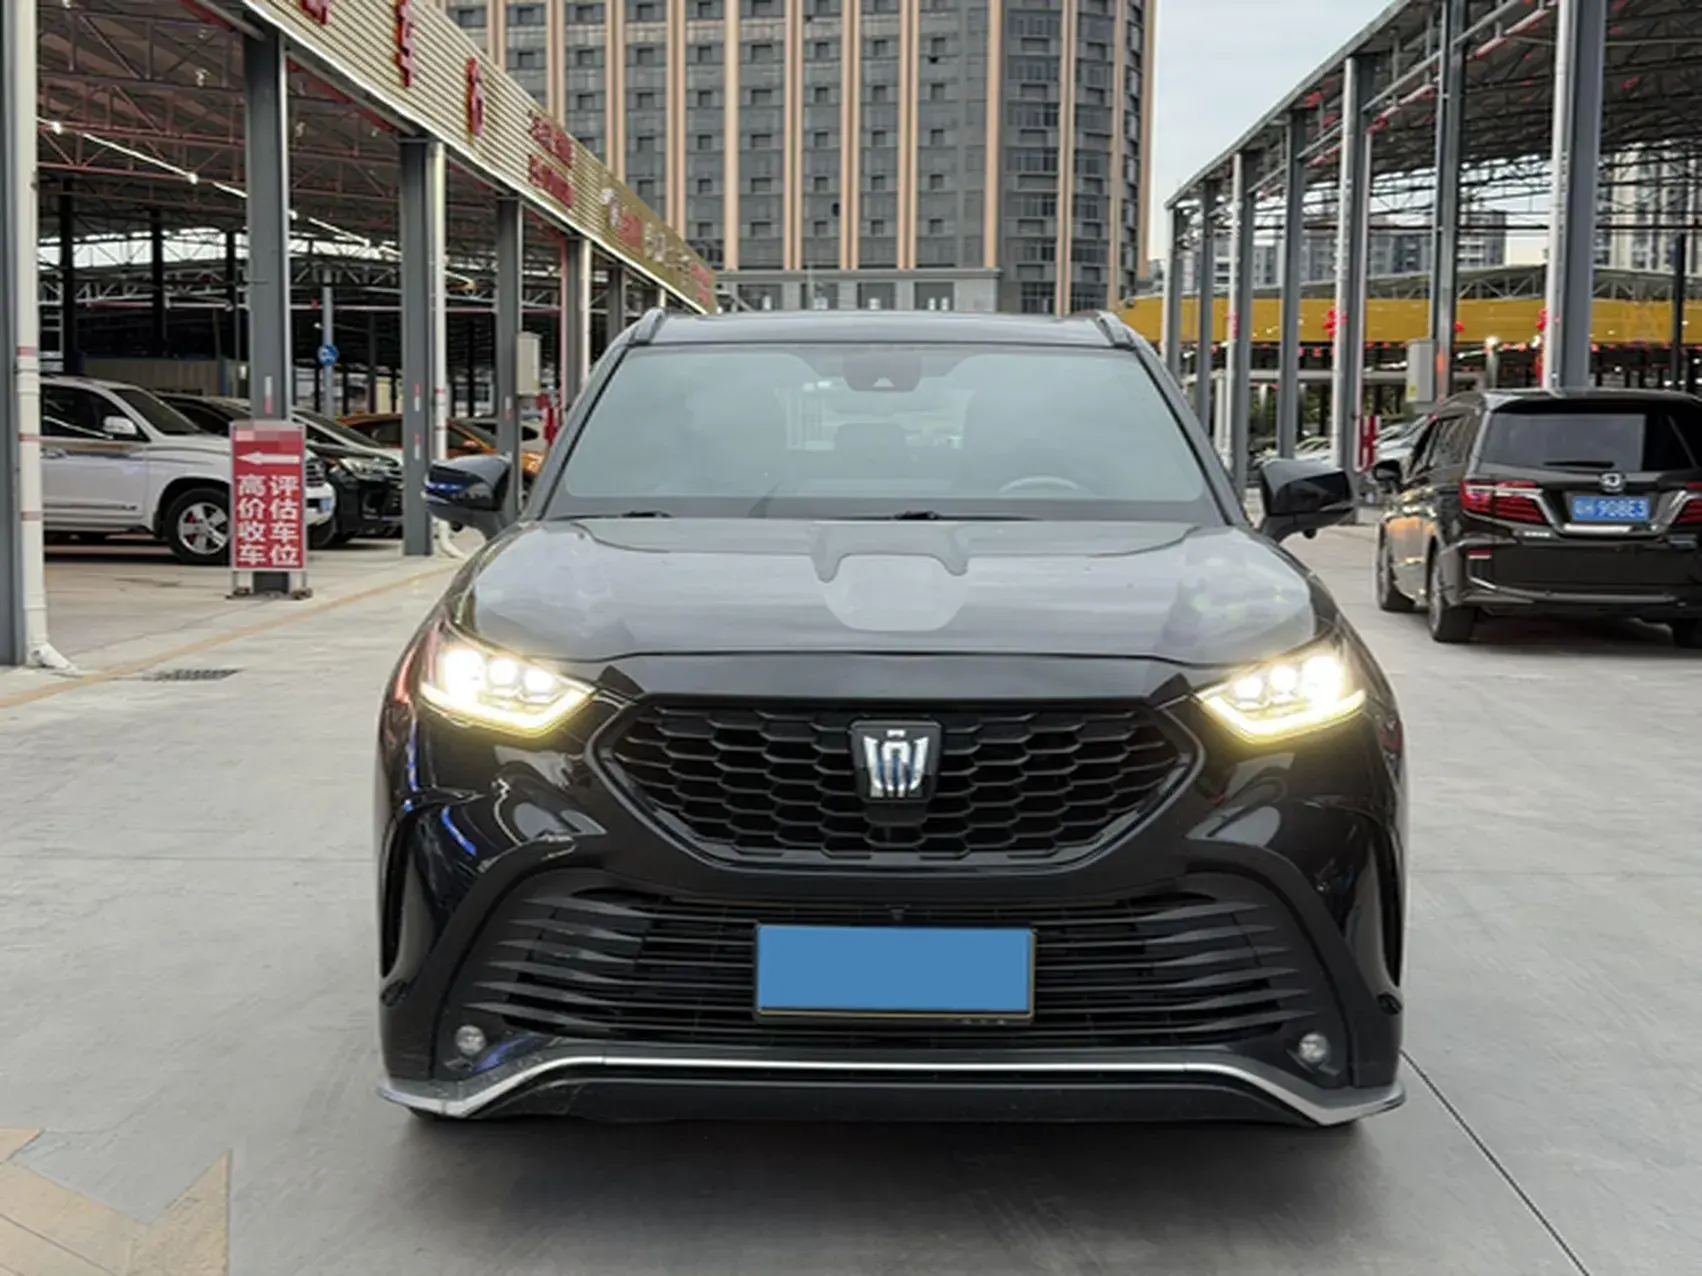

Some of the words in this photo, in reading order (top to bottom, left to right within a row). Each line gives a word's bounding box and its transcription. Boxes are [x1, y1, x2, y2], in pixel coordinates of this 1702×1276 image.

[237, 474, 267, 565] 高价收车
[268, 474, 300, 566] 评估车位
